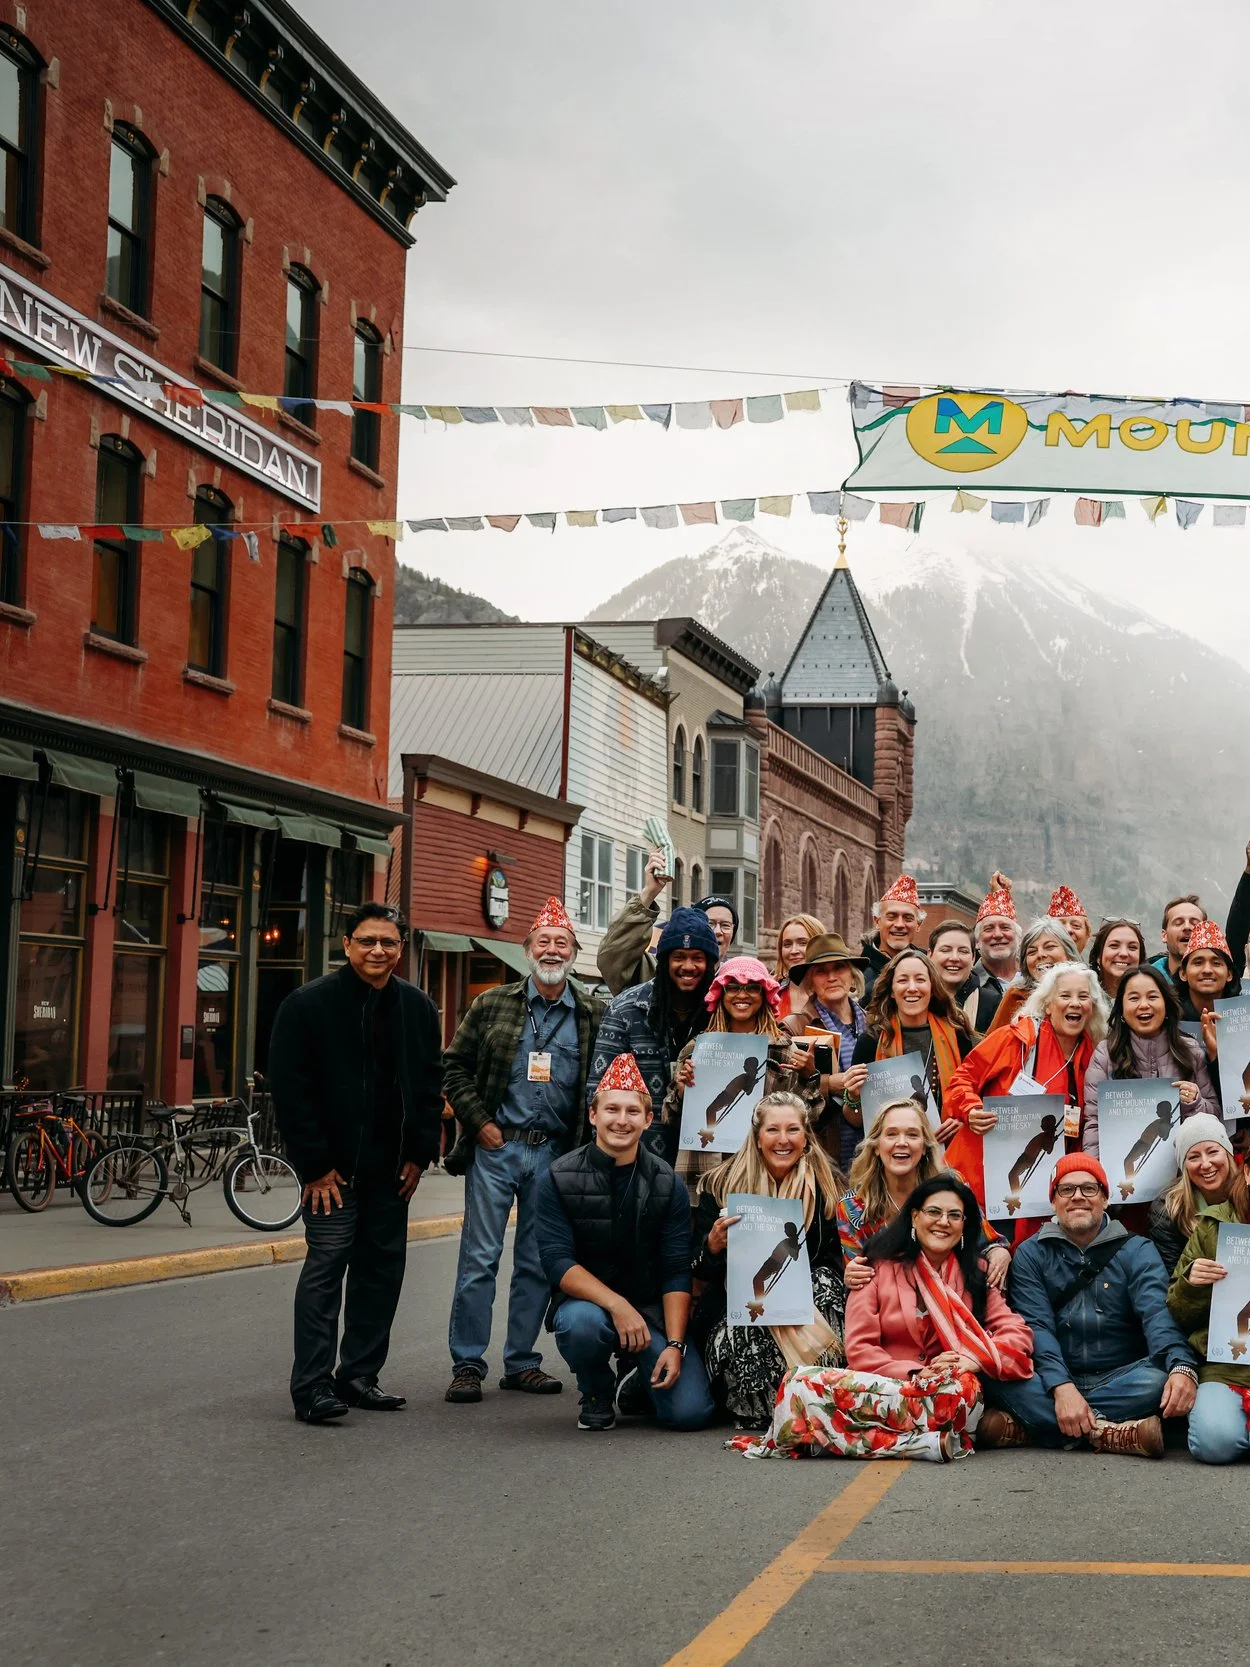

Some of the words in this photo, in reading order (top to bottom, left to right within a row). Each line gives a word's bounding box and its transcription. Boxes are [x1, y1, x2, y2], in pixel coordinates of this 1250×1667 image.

[0, 279, 101, 373] NEW
[33, 1005, 56, 1019] SHERIDAN
[1222, 1007, 1246, 1018] BETWEEN
[716, 1051, 744, 1059] MOUNTAIN
[867, 1070, 890, 1081] BETWEEN
[874, 1081, 884, 1089] THE
[885, 1075, 909, 1086] MOUNTAIN
[884, 1086, 894, 1094] THE
[895, 1083, 905, 1091] SKY
[1105, 1091, 1133, 1099] BETWEEN
[1126, 1098, 1156, 1107] MOUNTAIN
[991, 1106, 1019, 1115] BETWEEN
[1109, 1108, 1121, 1116] AND
[1135, 1107, 1147, 1115] SKY
[1011, 1113, 1041, 1121] MOUNTAIN
[1008, 1122, 1018, 1130] THE
[754, 1223, 765, 1231] THE
[1233, 1246, 1245, 1255] THE
[1228, 1256, 1242, 1264] AND
